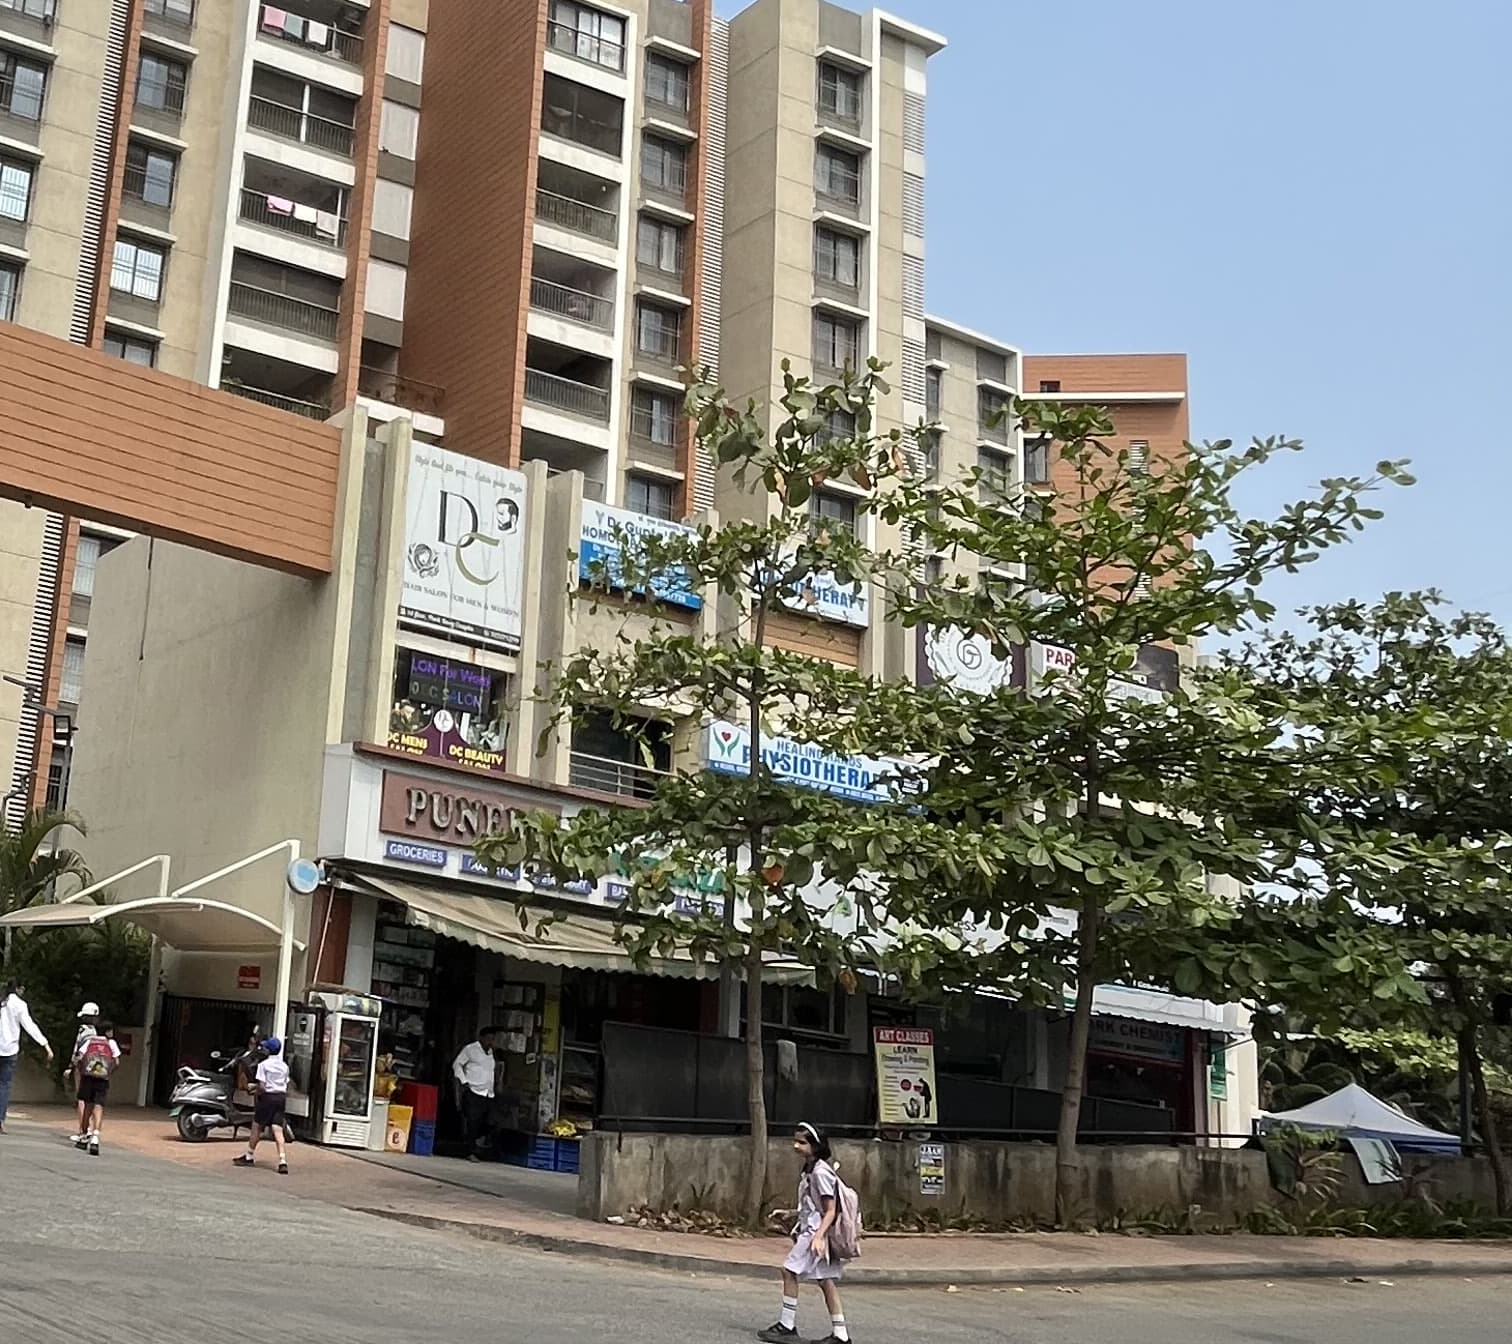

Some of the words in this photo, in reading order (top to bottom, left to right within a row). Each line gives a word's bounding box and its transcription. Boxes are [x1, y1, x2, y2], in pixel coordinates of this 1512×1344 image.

[464, 748, 504, 766] BEAUTY
[389, 843, 445, 864] GROCERIES
[896, 1030, 930, 1044] CLASSES
